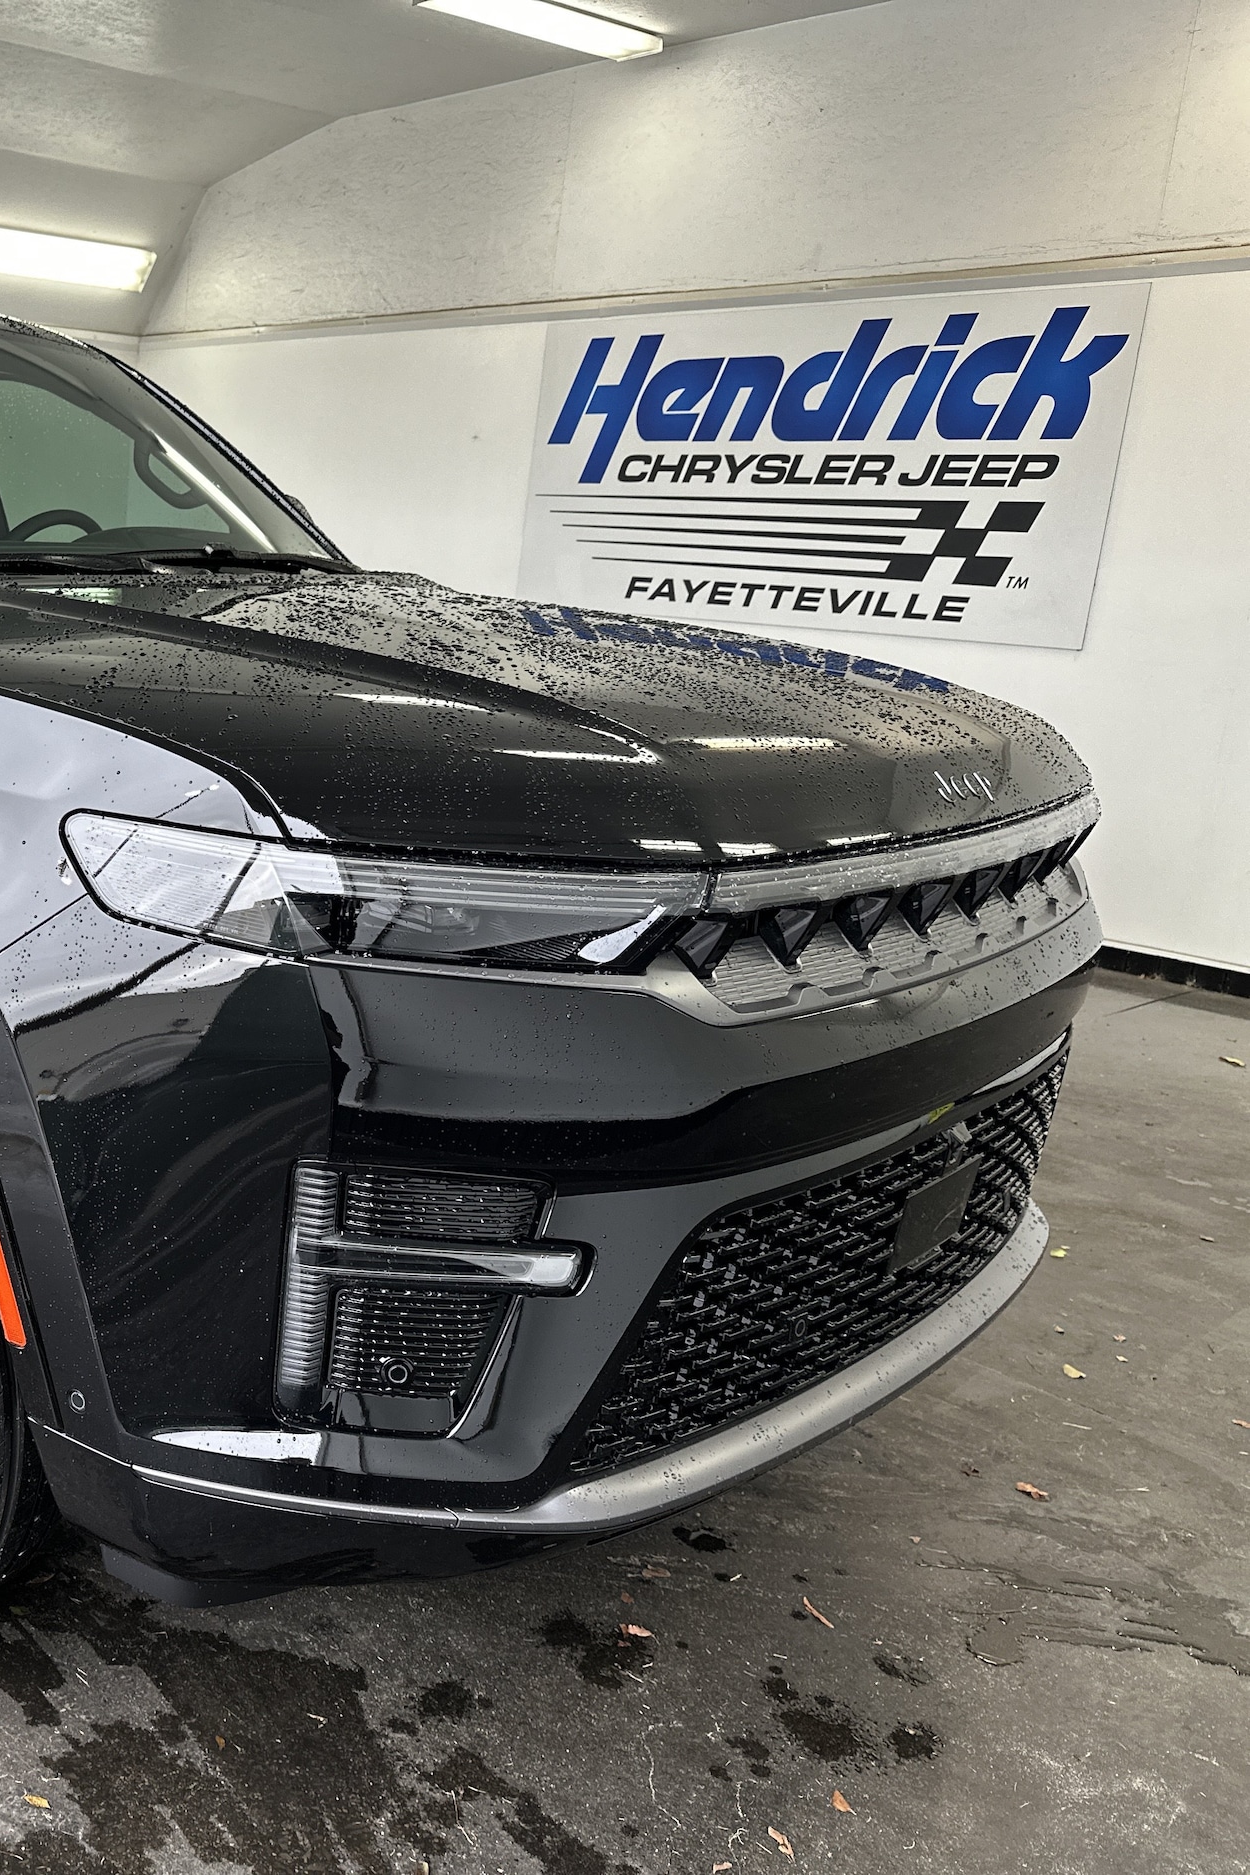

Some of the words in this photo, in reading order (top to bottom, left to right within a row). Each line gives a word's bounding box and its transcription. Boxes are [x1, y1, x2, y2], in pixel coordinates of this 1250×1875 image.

[548, 306, 1129, 485] Hendrick
[616, 454, 896, 487] CHRYSLER
[897, 454, 1060, 488] JEEP
[1006, 575, 1030, 590] TM
[625, 576, 970, 624] FAYETTEVILLE
[933, 771, 995, 804] Jeep
